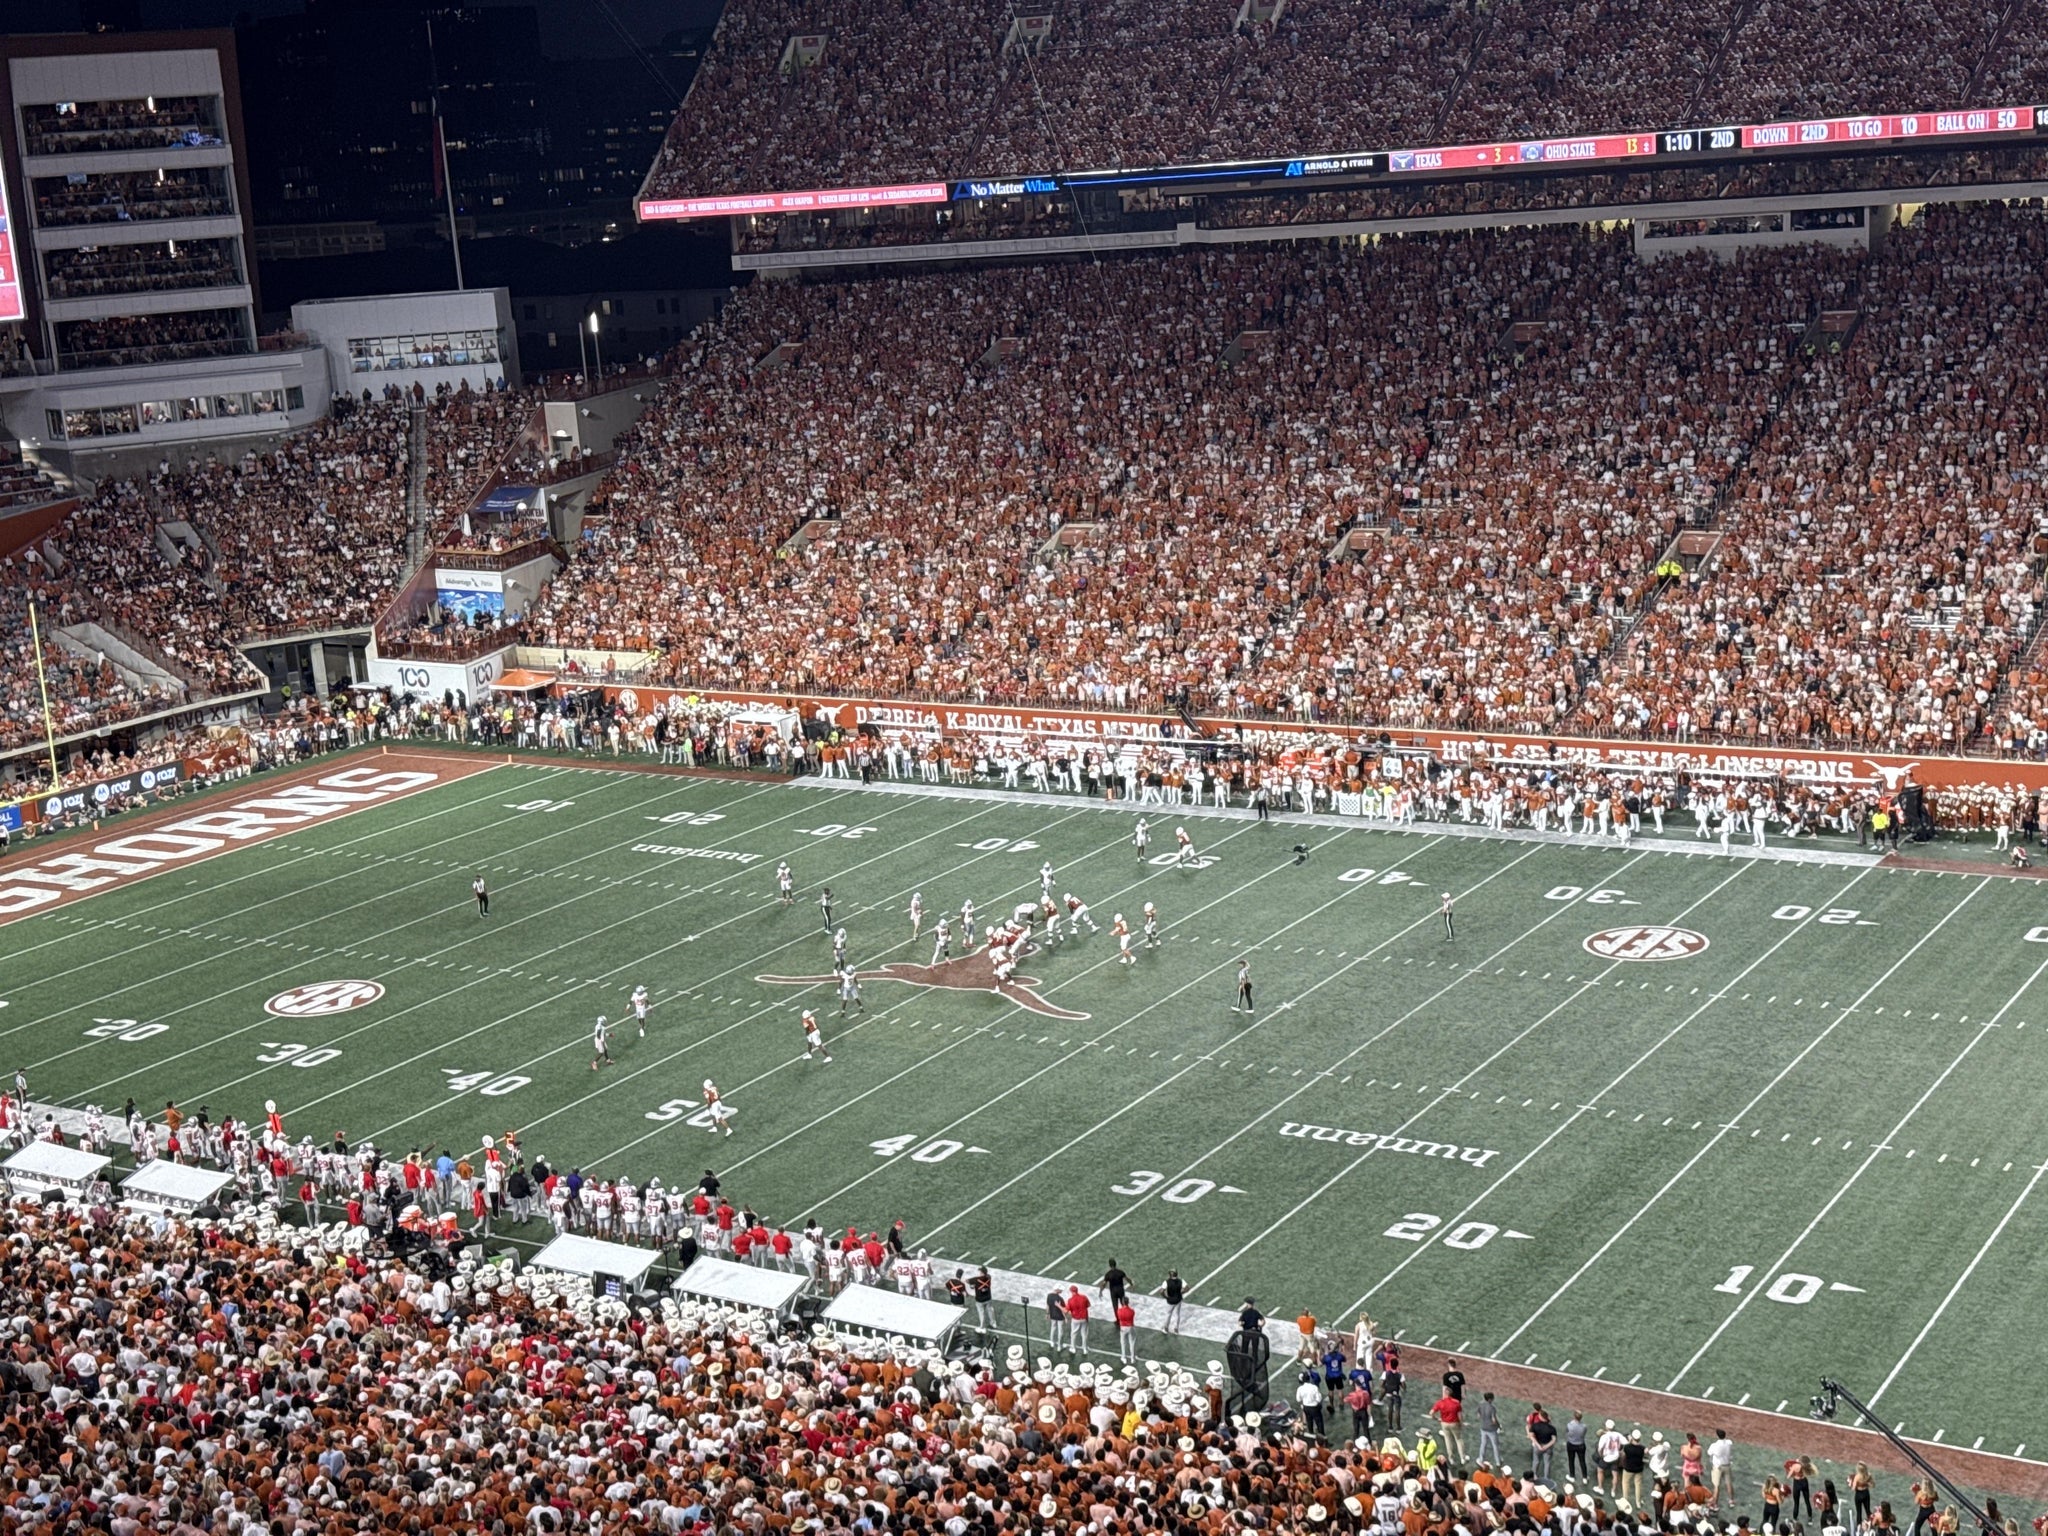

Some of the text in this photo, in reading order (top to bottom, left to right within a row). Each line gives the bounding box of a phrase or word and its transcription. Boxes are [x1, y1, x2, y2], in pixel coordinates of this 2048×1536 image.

[1901, 117, 1918, 134] 10
[1937, 112, 1985, 131] BALL ON
[1998, 110, 2017, 128] 50
[1753, 127, 1789, 144] DOWN
[1801, 124, 1828, 141] 2ND
[1848, 120, 1882, 137] TO GO
[1626, 138, 1638, 154] 13
[1665, 133, 1692, 152] 1:10
[1710, 130, 1735, 149] 2ND
[1494, 147, 1501, 163] 3
[1546, 142, 1596, 159] OHIO STATE
[1304, 160, 1340, 171] ARNOLD
[1349, 158, 1374, 168] ITKIN
[1415, 153, 1442, 168] TEXAS
[970, 179, 1060, 196] No Matter What.
[166, 704, 232, 732] BEVO XV
[945, 711, 960, 730] K
[156, 767, 177, 782] razr
[110, 779, 131, 795] razr
[63, 792, 85, 808] razr
[659, 811, 727, 825] 20
[810, 824, 878, 839] 30
[972, 838, 1041, 853] 40
[1337, 868, 1413, 885] 40
[1543, 885, 1626, 904] 30
[1771, 905, 1861, 925] 20
[82, 1018, 170, 1042] 20
[256, 1043, 343, 1068] 30
[446, 1071, 532, 1096] 40
[869, 1133, 965, 1163] 40
[1110, 1170, 1217, 1204] 30
[1382, 1212, 1500, 1250] 20
[1712, 1265, 1825, 1305] 10
